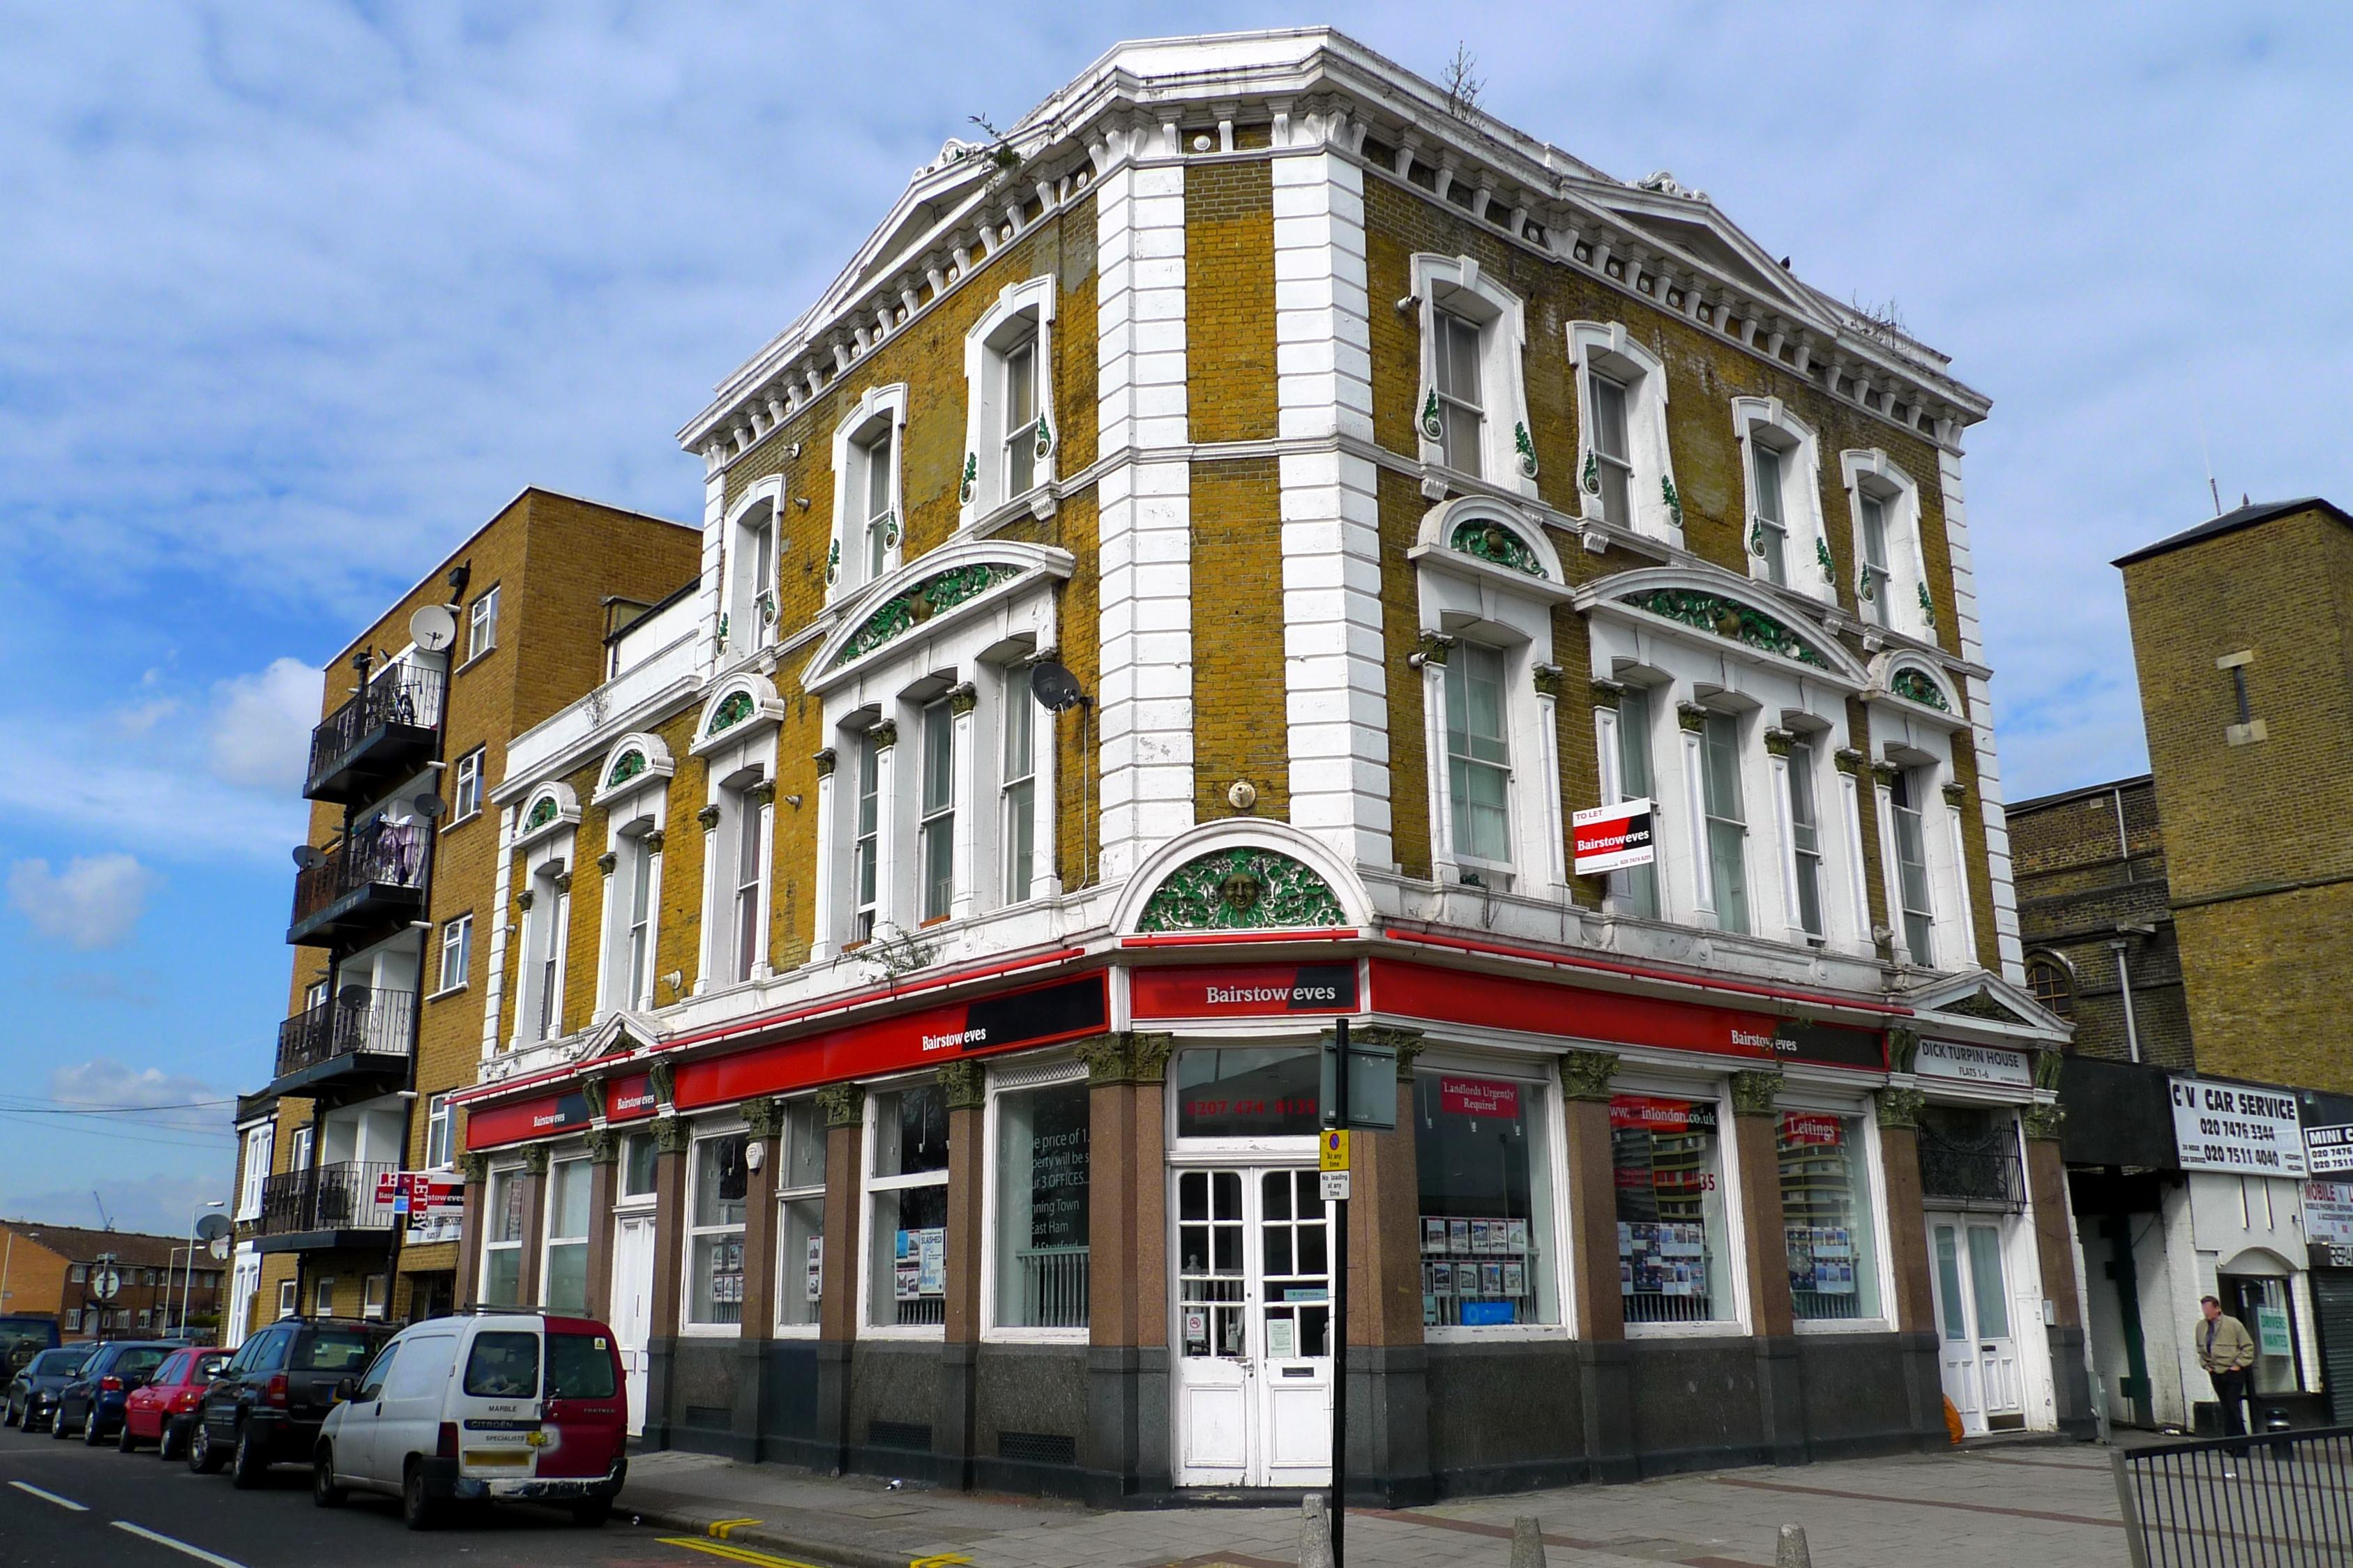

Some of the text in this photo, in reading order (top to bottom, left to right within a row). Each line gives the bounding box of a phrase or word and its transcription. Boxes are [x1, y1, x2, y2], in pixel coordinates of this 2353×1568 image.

[1589, 809, 1603, 818] LET
[1206, 985, 1336, 1003] Bairstow eves
[922, 1028, 986, 1051] Bairstow eves
[1775, 1039, 1797, 1051] eves
[1922, 1042, 2020, 1068] DICK TURPIN HOUSE
[1958, 1066, 1976, 1077] FLATS
[1978, 1070, 1989, 1079] 1-6
[1443, 1082, 1515, 1101] Landlords Urgently
[617, 1095, 654, 1110] Bairstow eves
[1464, 1098, 1497, 1111] Required
[2204, 1089, 2235, 1113] CAR
[2239, 1093, 2296, 1120] SERVICE
[1790, 1117, 1835, 1141] Lettings
[2200, 1118, 2220, 1136] 020
[2223, 1121, 2249, 1139] 7476
[2309, 1129, 2342, 1145] MINI
[1042, 1132, 1067, 1150] price
[1069, 1127, 1080, 1145] of
[1032, 1155, 1054, 1171] perty
[1055, 1152, 1070, 1166] will
[1072, 1151, 1083, 1164] be
[2204, 1144, 2279, 1167] 020 7511 4040
[2312, 1147, 2352, 1158] 020 7476
[2314, 1158, 2353, 1169] 020 7511
[2305, 1183, 2336, 1201] MOBILE
[411, 1175, 430, 1231] LET BY
[1032, 1198, 1080, 1216] nning Town
[1049, 1221, 1068, 1234] Ham
